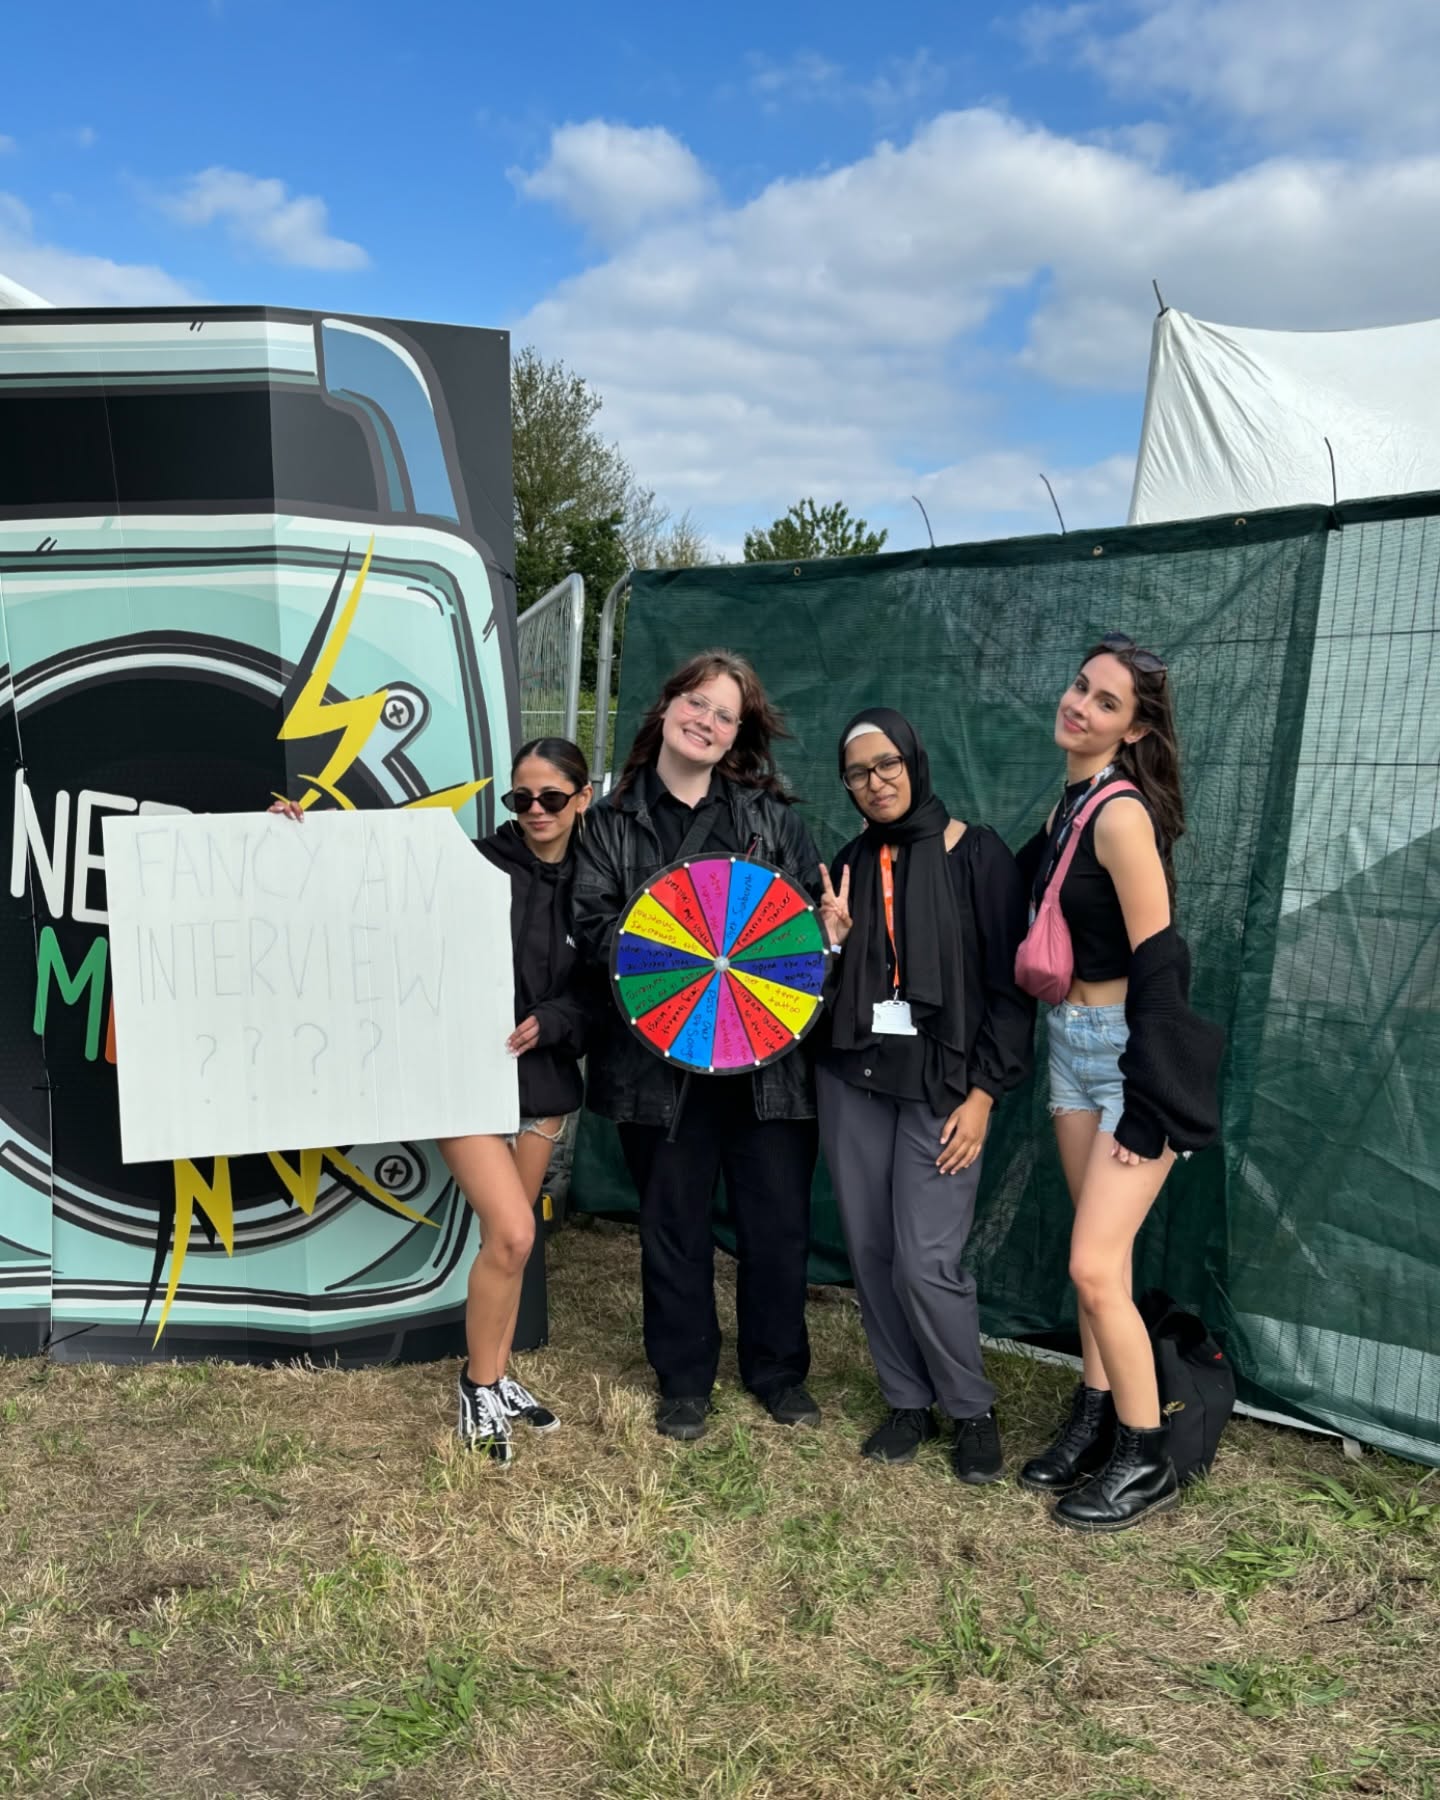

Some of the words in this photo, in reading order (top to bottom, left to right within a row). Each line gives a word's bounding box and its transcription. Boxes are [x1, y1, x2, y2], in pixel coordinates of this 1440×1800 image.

[10, 768, 195, 925] NE
[135, 827, 322, 900] FANCY
[353, 829, 443, 913] AN
[33, 925, 117, 1064] M
[136, 918, 445, 1016] INTERVIEW
